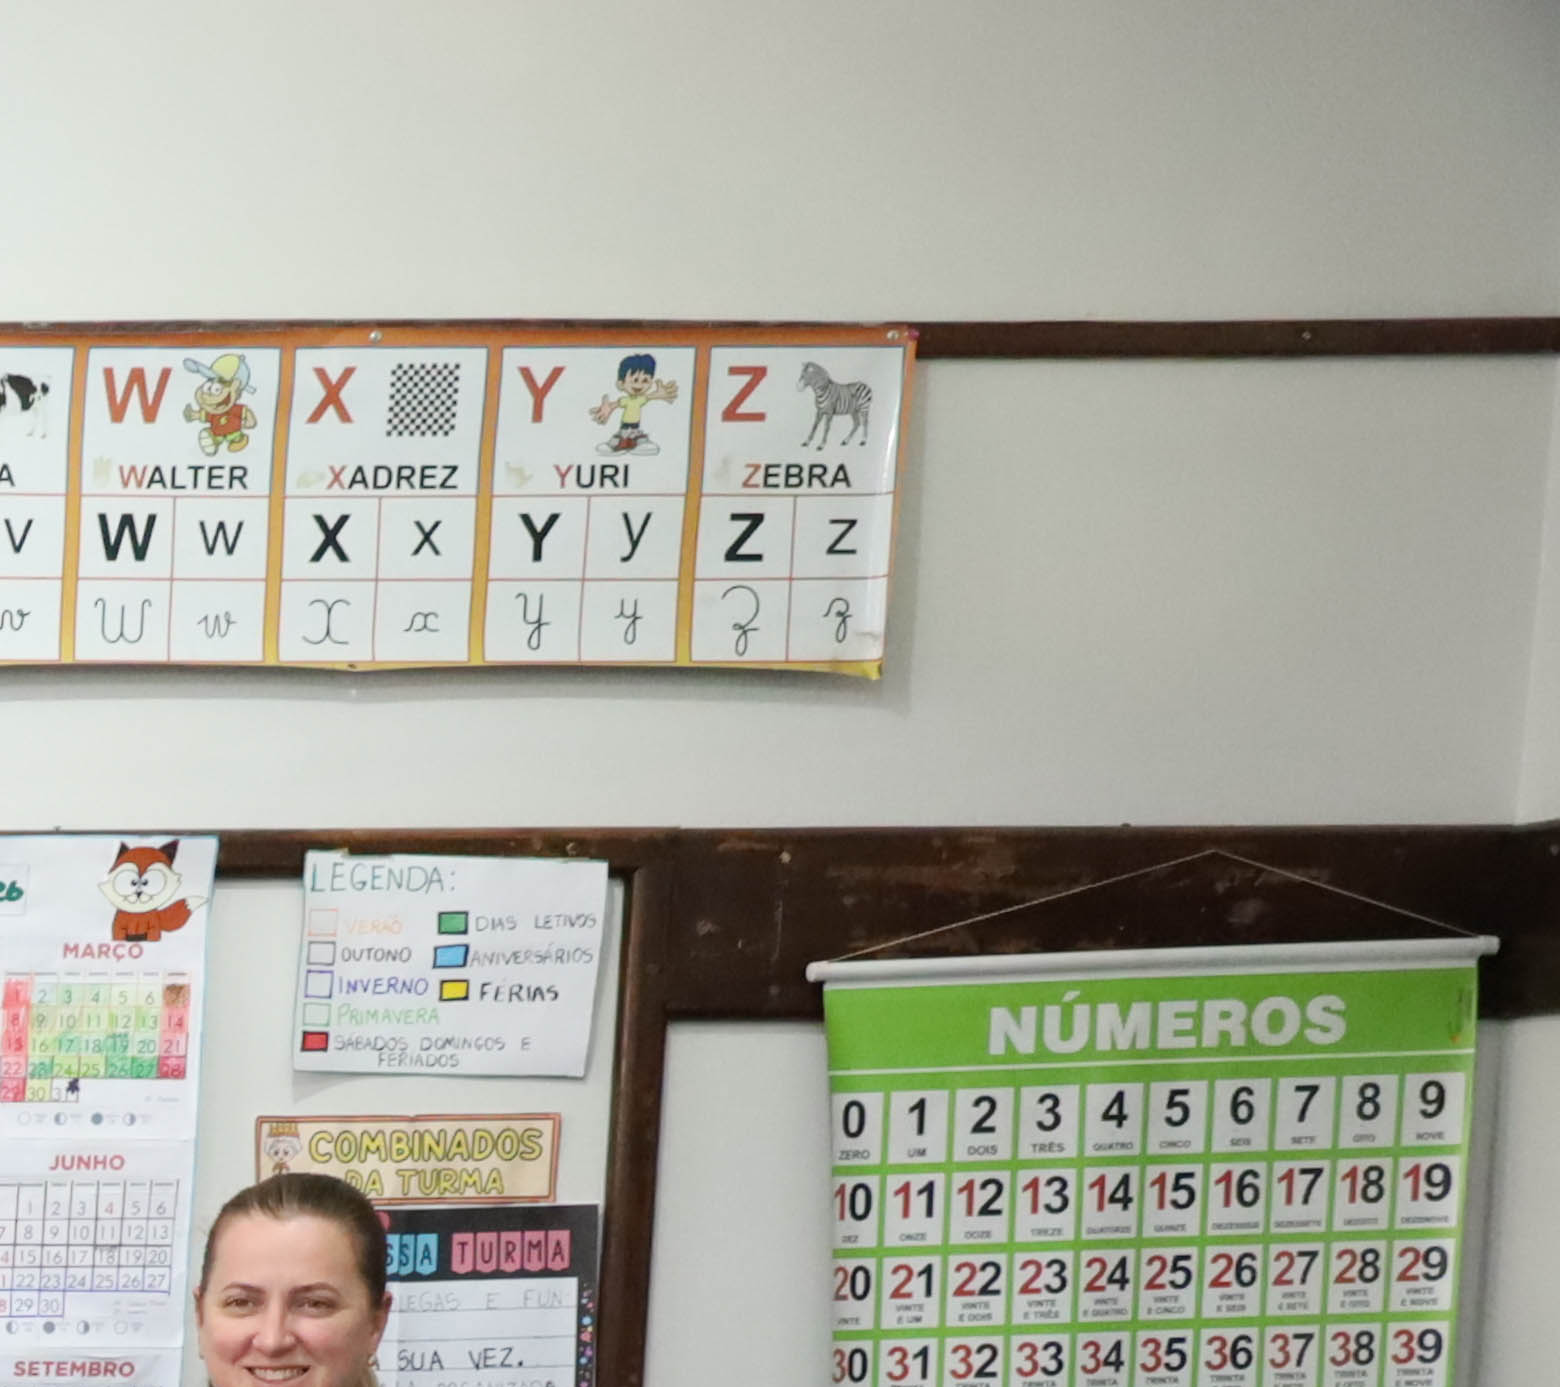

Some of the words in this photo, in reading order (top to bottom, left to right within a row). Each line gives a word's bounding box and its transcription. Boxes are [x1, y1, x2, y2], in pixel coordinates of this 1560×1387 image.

[305, 366, 357, 423] X
[722, 367, 766, 422] Z
[118, 463, 249, 491] WALTER
[325, 463, 459, 491] XADREZ
[553, 463, 631, 490] YURI
[742, 463, 852, 489] ZEBRA
[311, 863, 456, 893] LEGENDA:
[475, 915, 517, 931] DIAS
[63, 941, 143, 962] MARÇO
[341, 947, 412, 963] OUTONO
[337, 977, 428, 996] INVERNO
[336, 1004, 440, 1025] PRIMAVERA
[988, 991, 1347, 1055] NÚMEROS
[521, 1037, 531, 1049] E
[378, 1053, 460, 1068] FERIADOS
[1419, 1081, 1445, 1118] 9
[309, 1129, 543, 1163] COMBINADOS
[397, 1168, 505, 1196] TURMA
[1403, 1164, 1452, 1201] 19
[456, 1240, 566, 1265] TURMA
[1145, 1255, 1192, 1290] 25
[13, 1361, 135, 1378] SETEMBRO
[397, 1350, 444, 1372] SUA
[469, 1348, 524, 1370] VEZ.
